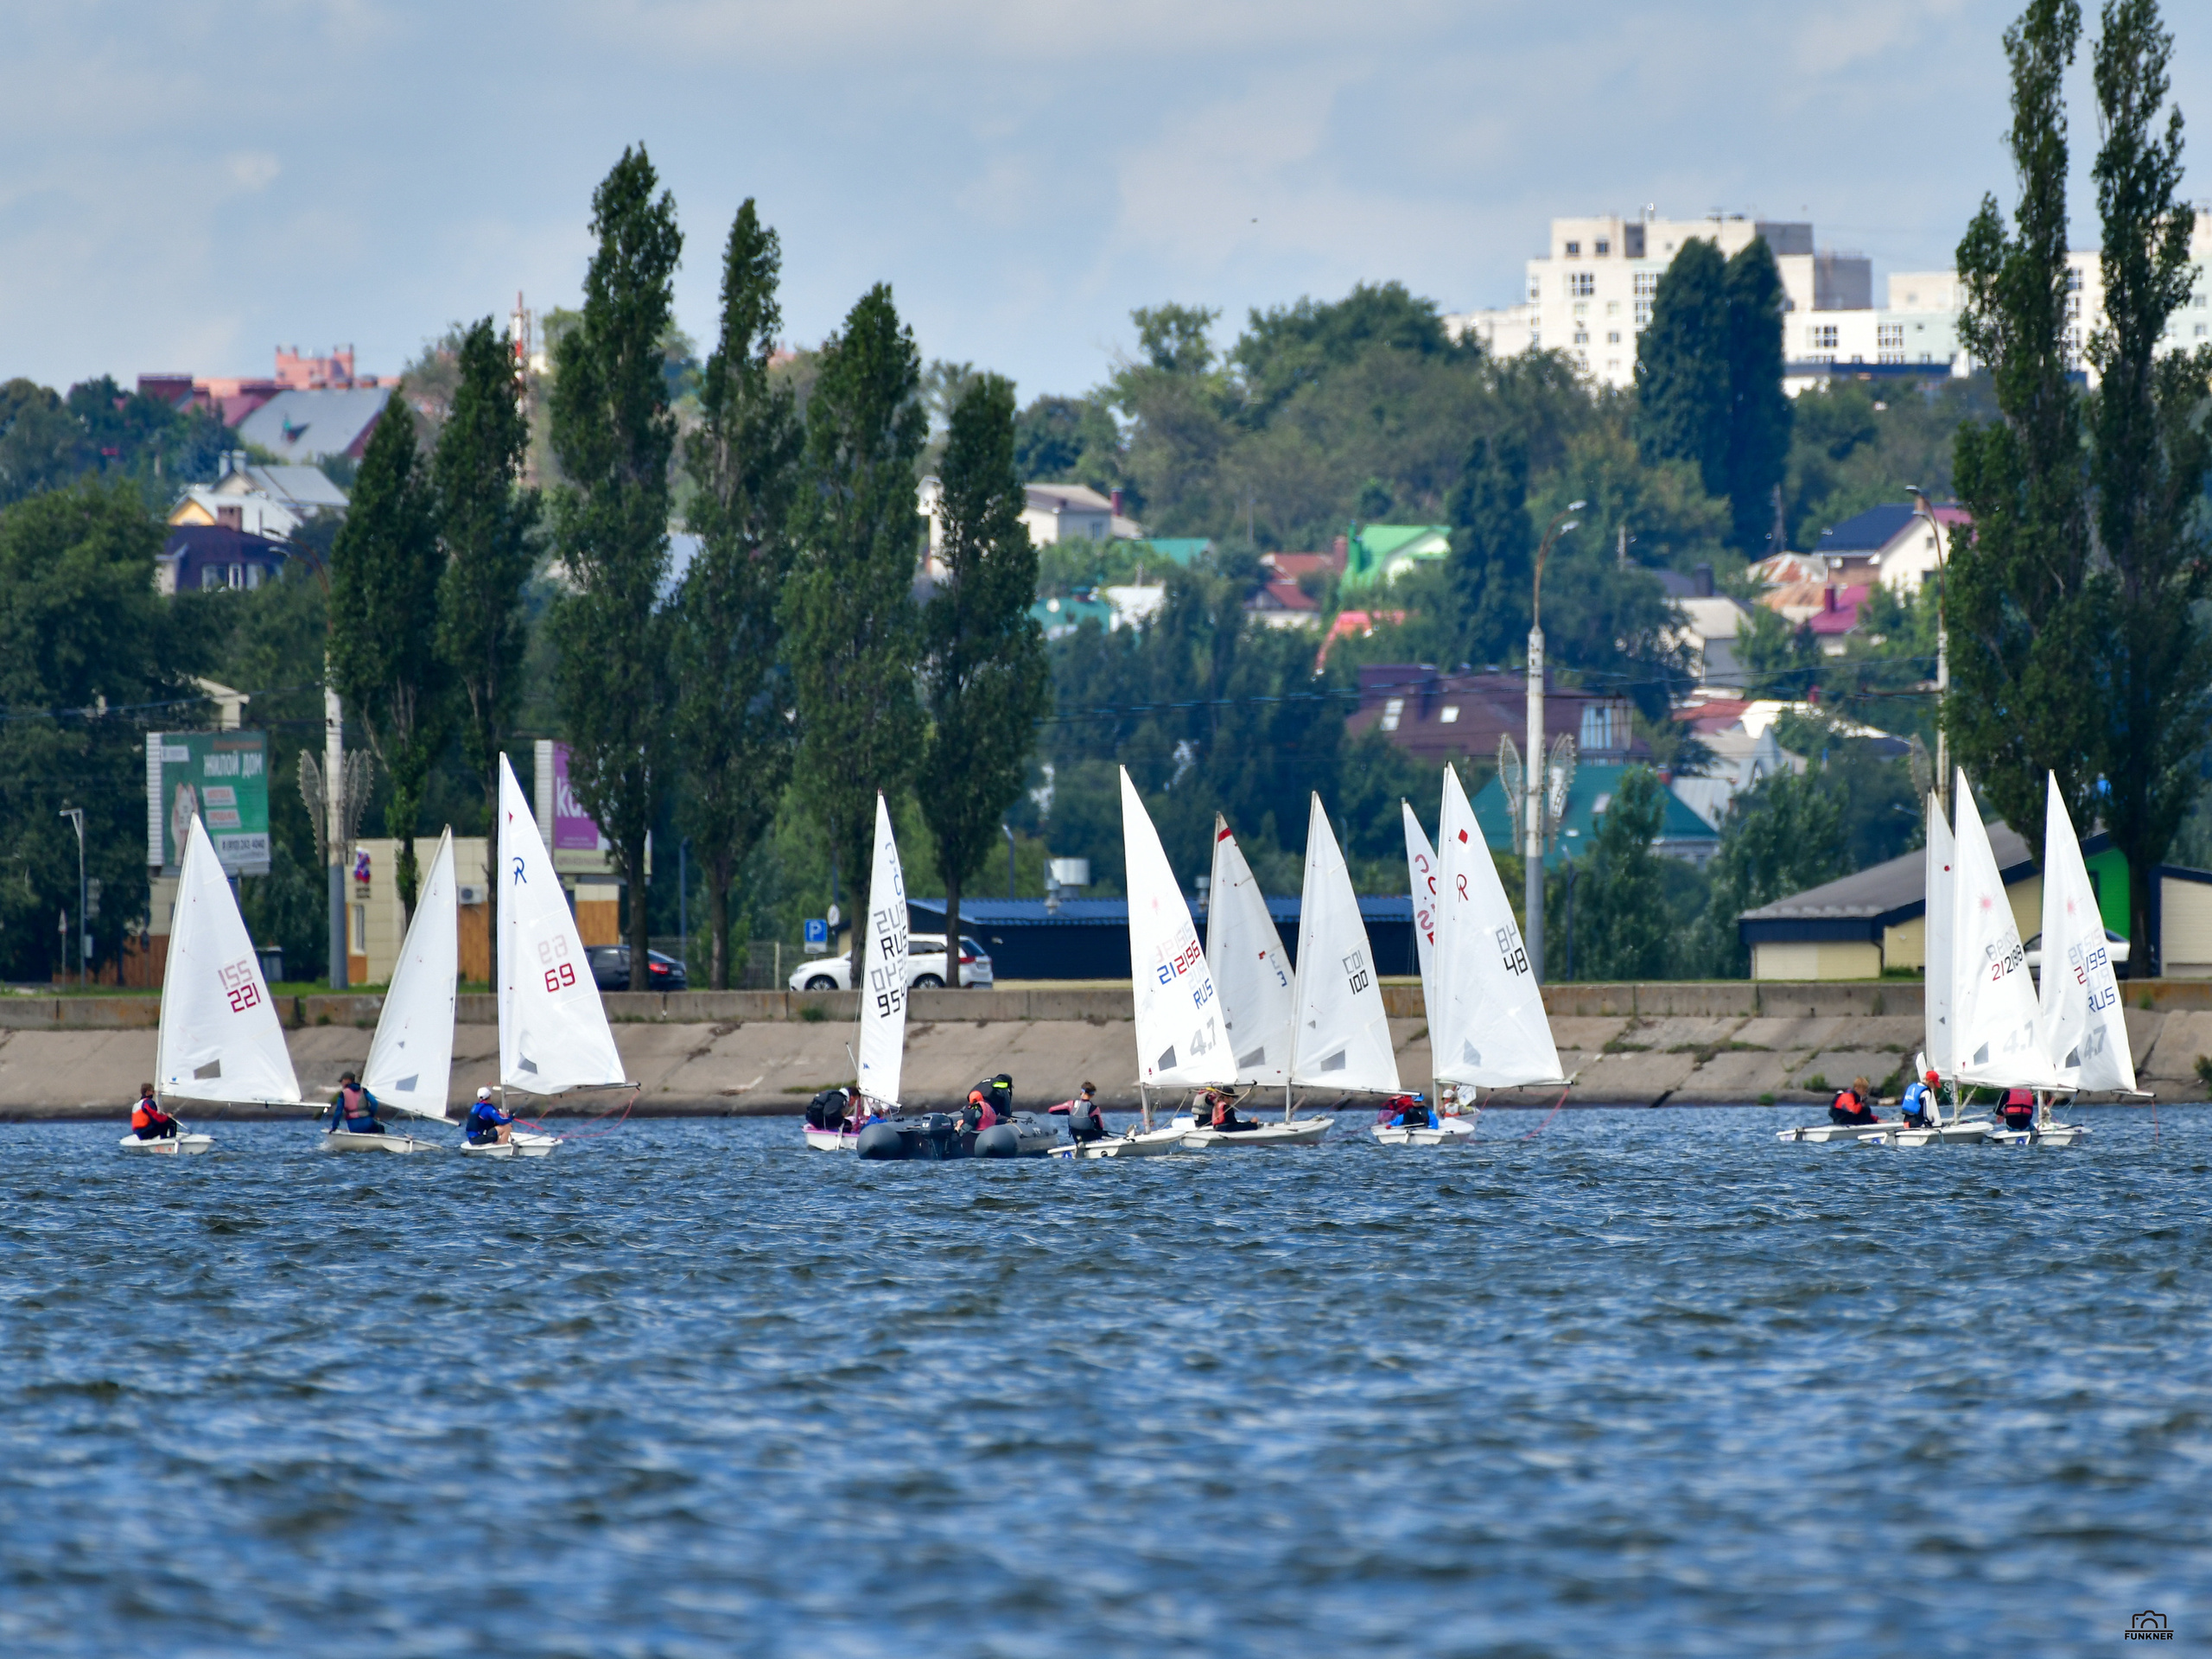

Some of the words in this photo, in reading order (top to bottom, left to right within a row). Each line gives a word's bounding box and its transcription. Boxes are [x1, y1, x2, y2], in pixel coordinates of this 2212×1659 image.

[242, 753, 262, 779] ДОМ
[809, 921, 822, 941] P
[880, 925, 907, 961] RUS
[1157, 939, 1200, 985] 212196
[1503, 947, 1528, 976] 48
[544, 963, 575, 993] 69
[1192, 977, 1213, 1009] RUS
[1349, 969, 1370, 995] 100
[227, 982, 261, 1013] 221
[1190, 1016, 1216, 1056] 4.7
[2003, 1020, 2034, 1054] 4.7
